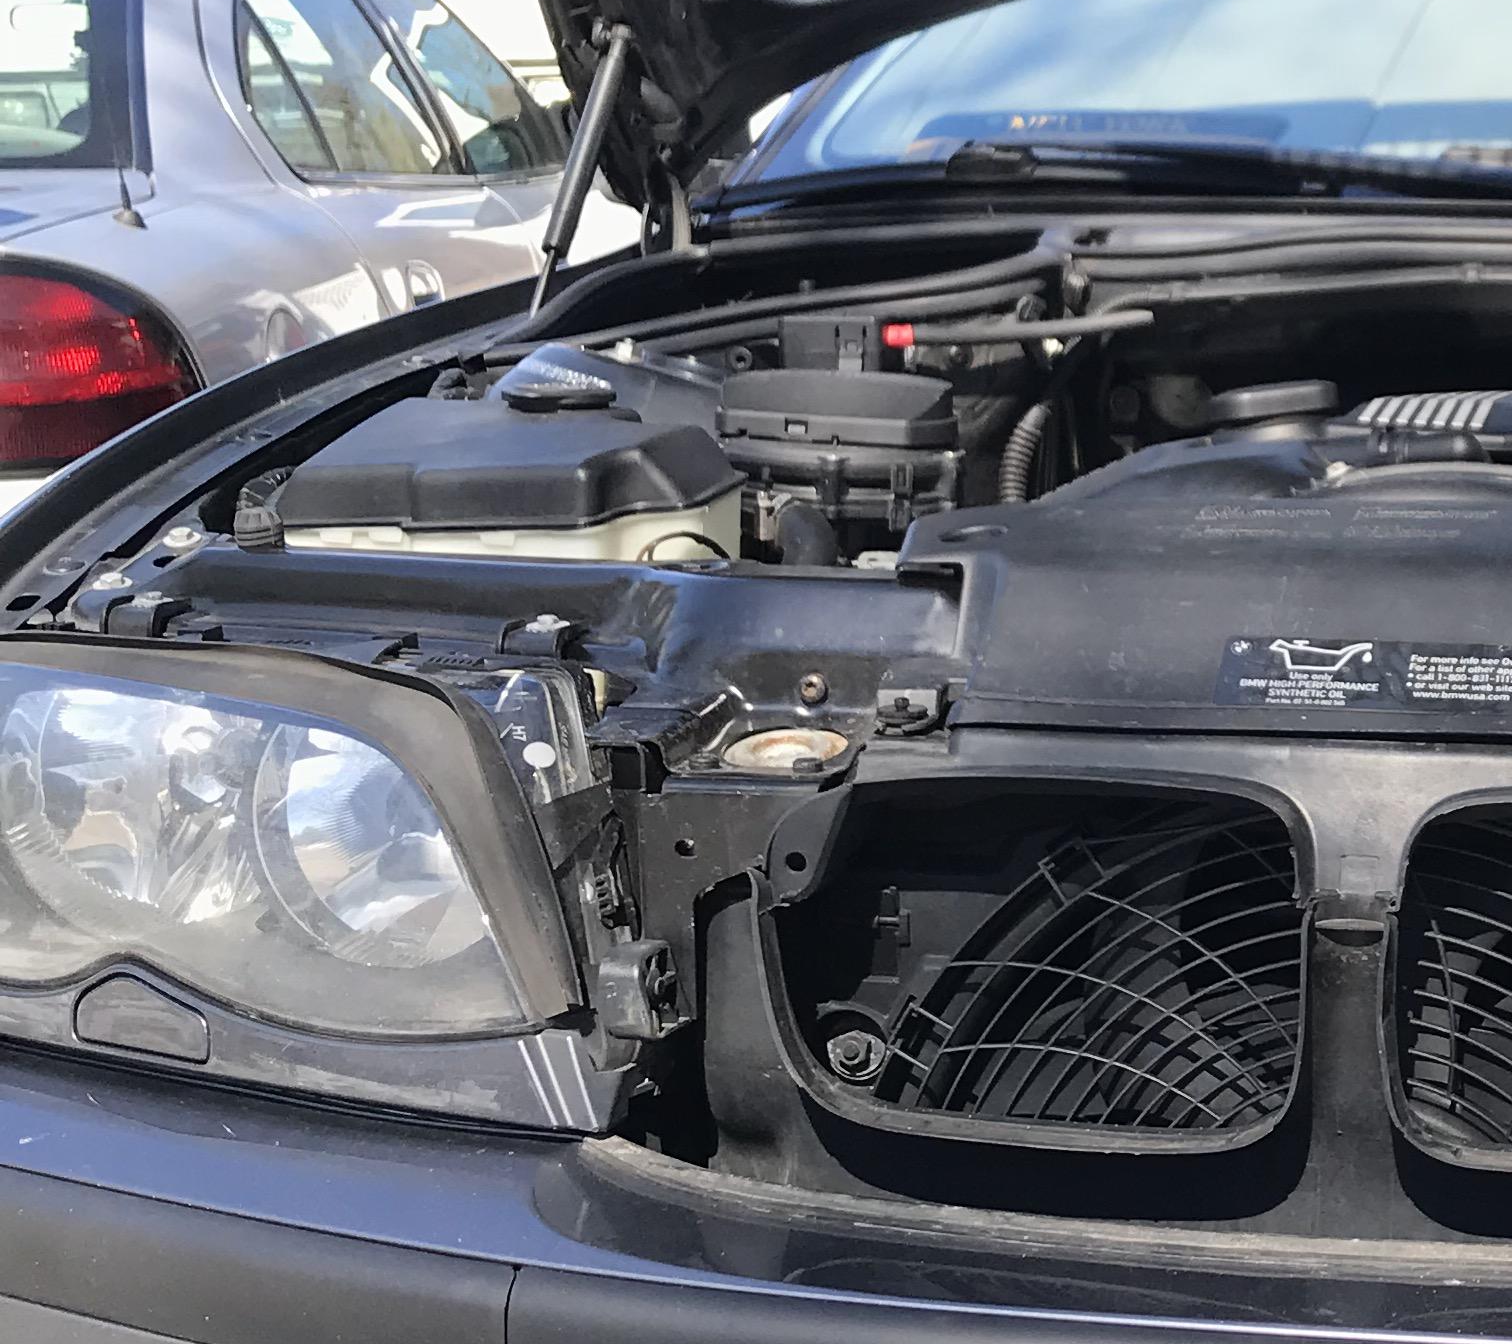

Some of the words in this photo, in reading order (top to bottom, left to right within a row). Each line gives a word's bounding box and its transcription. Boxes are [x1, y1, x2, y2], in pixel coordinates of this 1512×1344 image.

[1410, 655, 1428, 663] For
[1430, 657, 1458, 665] more
[1459, 656, 1480, 665] info
[1481, 658, 1500, 666] see
[1409, 663, 1427, 671] For
[1437, 664, 1454, 673] list
[1455, 665, 1466, 673] of
[1467, 665, 1495, 674] other
[1289, 672, 1309, 680] Use
[1311, 673, 1334, 682] only
[1416, 673, 1435, 681] call
[1240, 678, 1267, 687] BMW
[1268, 680, 1297, 688] HIGH
[1297, 681, 1379, 692] PERFORMANCE
[1428, 681, 1450, 690] visit
[1471, 684, 1493, 692] web
[1268, 688, 1327, 698] SYNTHETIC
[1328, 690, 1346, 699] OIL
[1413, 691, 1510, 701] www.bmwusa.com
[511, 725, 527, 742] H7
